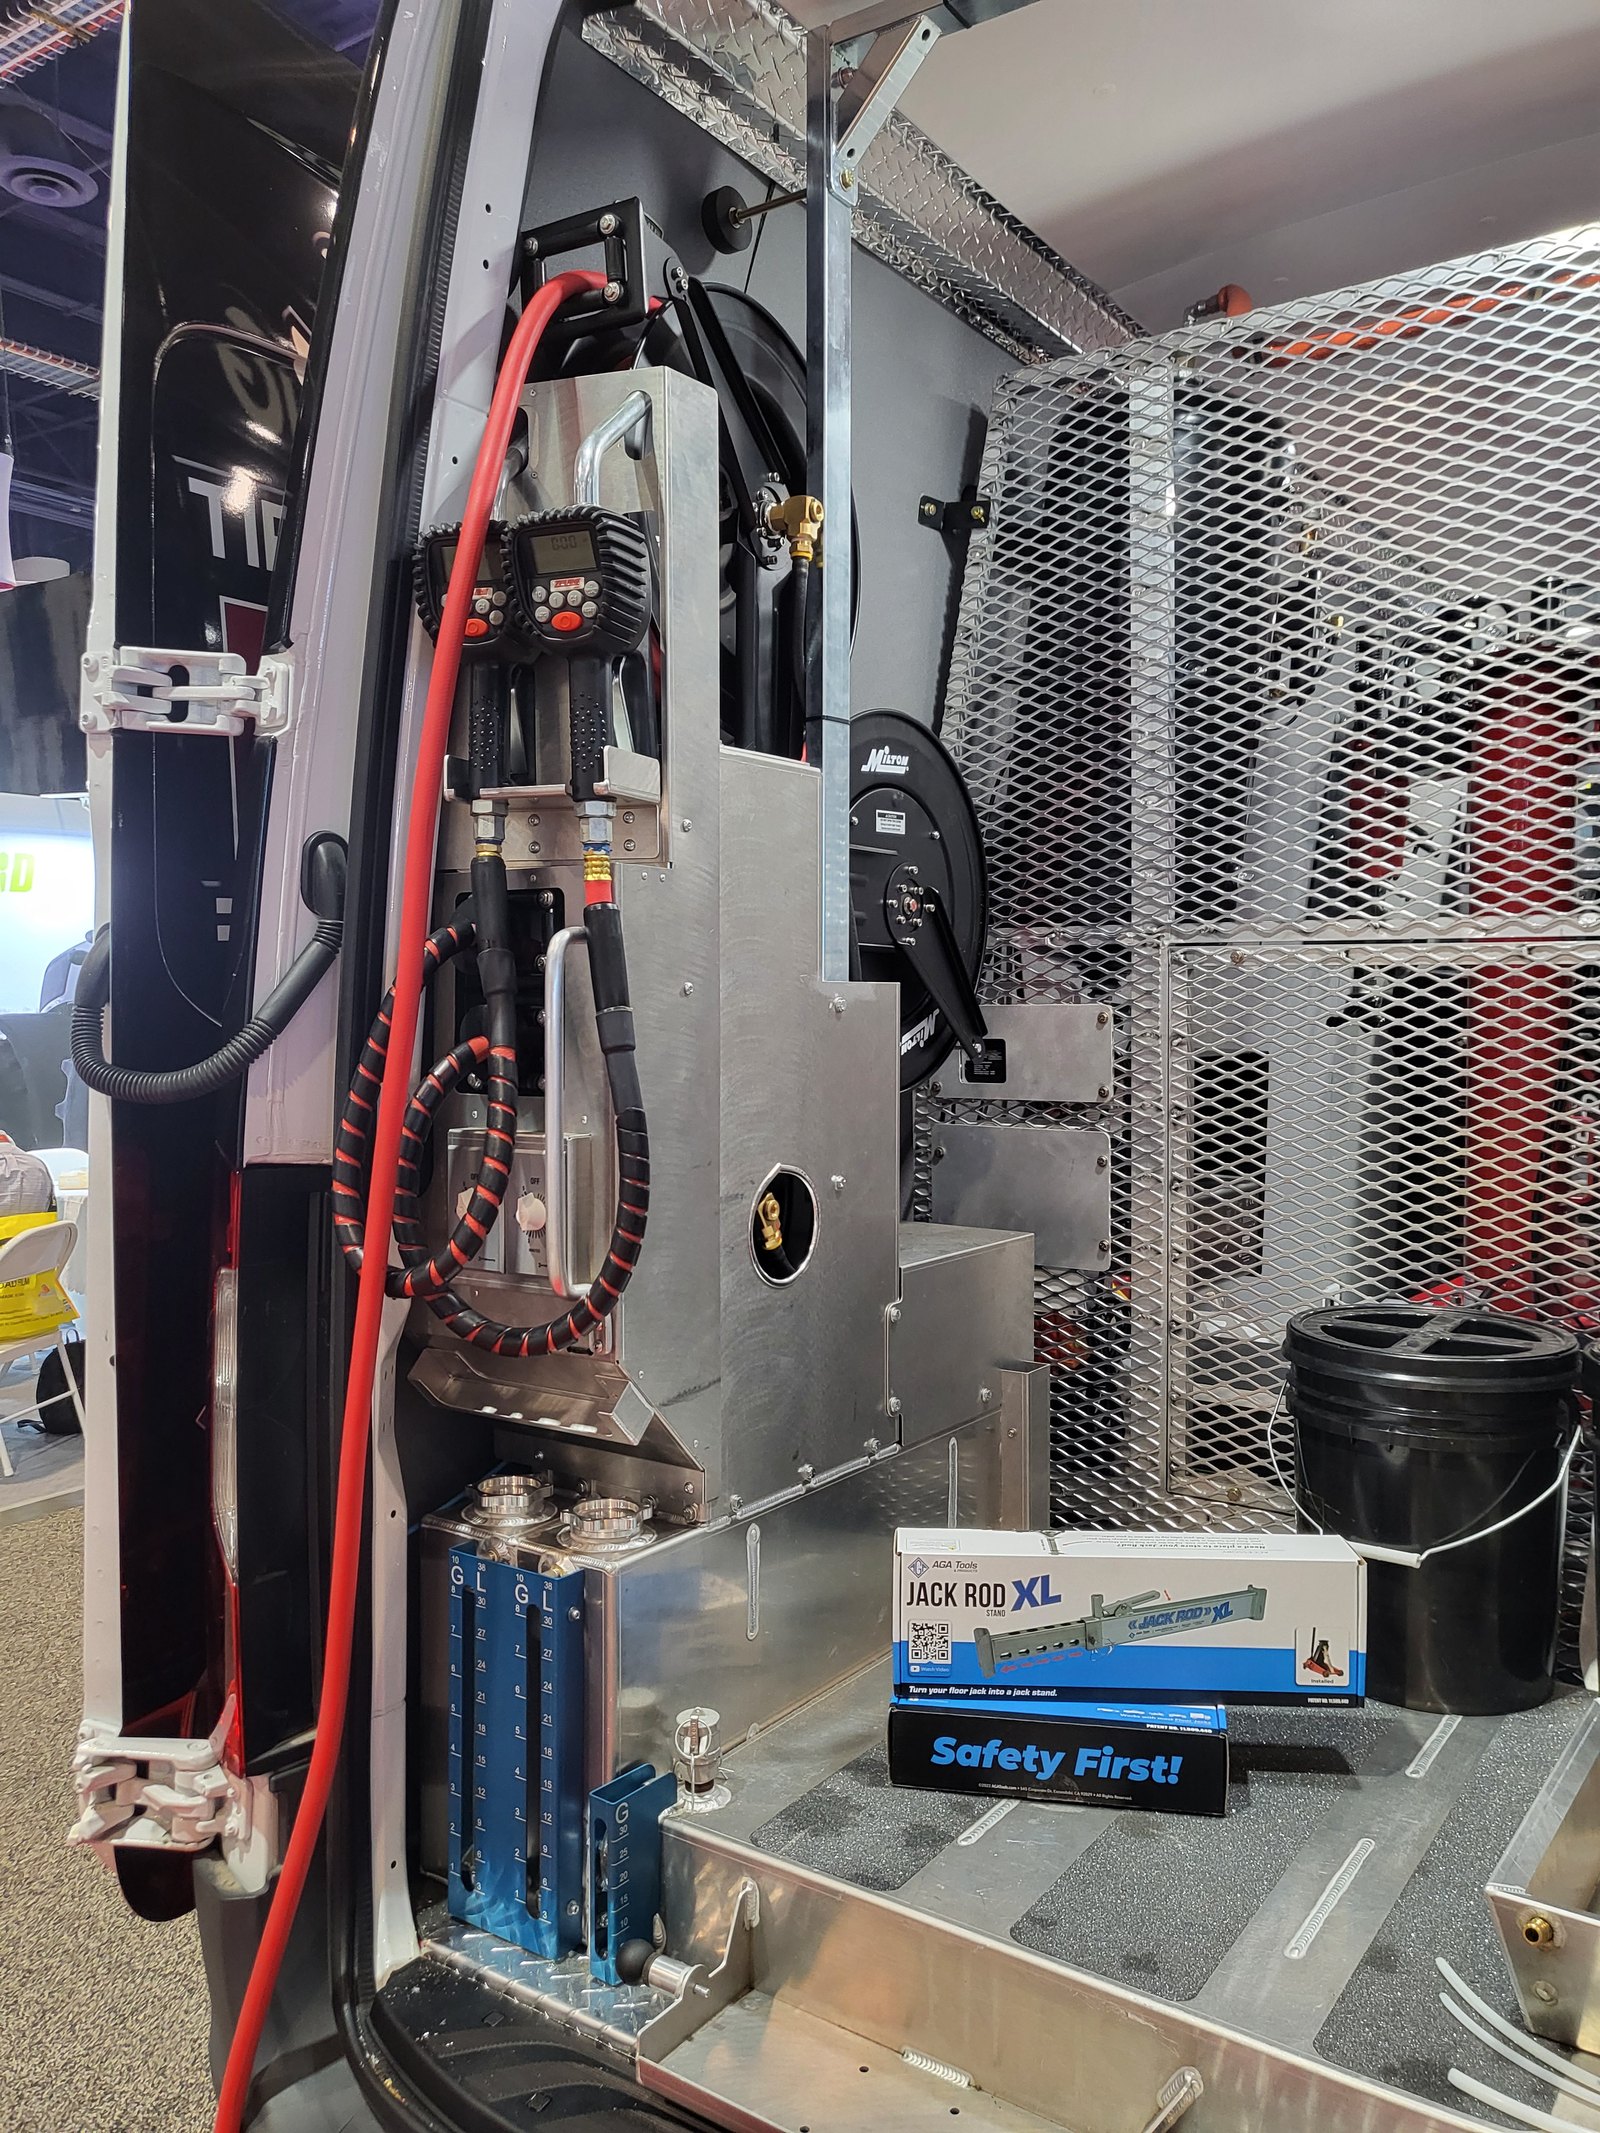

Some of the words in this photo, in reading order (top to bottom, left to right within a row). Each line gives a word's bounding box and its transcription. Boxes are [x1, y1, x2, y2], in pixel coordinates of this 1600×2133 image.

[530, 1177, 540, 1185] OFF
[451, 1555, 460, 1564] 10
[477, 1562, 486, 1572] 38
[932, 1561, 952, 1569] AGA
[955, 1561, 978, 1570] Tools
[451, 1565, 464, 1585] G
[516, 1573, 524, 1583] 10
[476, 1571, 487, 1593] L
[544, 1581, 553, 1591] 38
[451, 1585, 456, 1593] 8
[515, 1583, 529, 1604] G
[907, 1582, 958, 1607] JACK
[965, 1582, 1006, 1608] ROD
[1011, 1574, 1062, 1612] XL
[477, 1597, 486, 1605] 30
[542, 1590, 554, 1613] L
[515, 1604, 520, 1613] 8
[986, 1609, 1006, 1618] STAND
[1139, 1611, 1176, 1630] JACK
[1176, 1607, 1202, 1623] ROD
[1211, 1601, 1234, 1624] XL
[544, 1616, 553, 1626] 30
[451, 1625, 456, 1633] 7
[477, 1628, 486, 1637] 27
[515, 1645, 520, 1653] 7
[544, 1648, 552, 1658] 27
[451, 1664, 456, 1673] 6
[477, 1659, 486, 1669] 24
[515, 1685, 520, 1694] 6
[544, 1681, 553, 1691] 24
[477, 1691, 486, 1700] 21
[909, 1686, 928, 1694] Turn
[929, 1688, 948, 1696] your
[949, 1687, 968, 1695] floor
[969, 1688, 987, 1696] jack
[988, 1688, 1005, 1696] into
[1013, 1688, 1031, 1697] jack
[1032, 1689, 1058, 1697] stand.
[451, 1704, 456, 1712] 5
[544, 1714, 552, 1723] 21
[478, 1724, 486, 1733] 18
[515, 1726, 520, 1735] 5
[544, 1747, 553, 1757] 18
[478, 1755, 486, 1765] 15
[930, 1736, 1066, 1781] Safety
[1074, 1745, 1184, 1785] First!
[515, 1767, 520, 1775] 4
[451, 1783, 455, 1791] 3
[544, 1779, 553, 1789] 15
[478, 1787, 486, 1796] 12
[515, 1808, 520, 1816] 3
[615, 1802, 629, 1824] G
[544, 1812, 552, 1822] 12
[450, 1823, 455, 1831] 2
[477, 1819, 482, 1827] 9
[619, 1825, 628, 1834] 30
[515, 1849, 520, 1857] 2
[543, 1845, 548, 1853] 9
[620, 1847, 628, 1857] 25
[477, 1851, 482, 1859] 6
[451, 1863, 454, 1871] 1
[620, 1870, 629, 1881] 20
[477, 1882, 482, 1891] 3
[543, 1878, 548, 1886] 6
[515, 1890, 519, 1898] 1
[620, 1894, 629, 1905] 15
[543, 1911, 548, 1919] 3
[620, 1917, 629, 1927] 10
